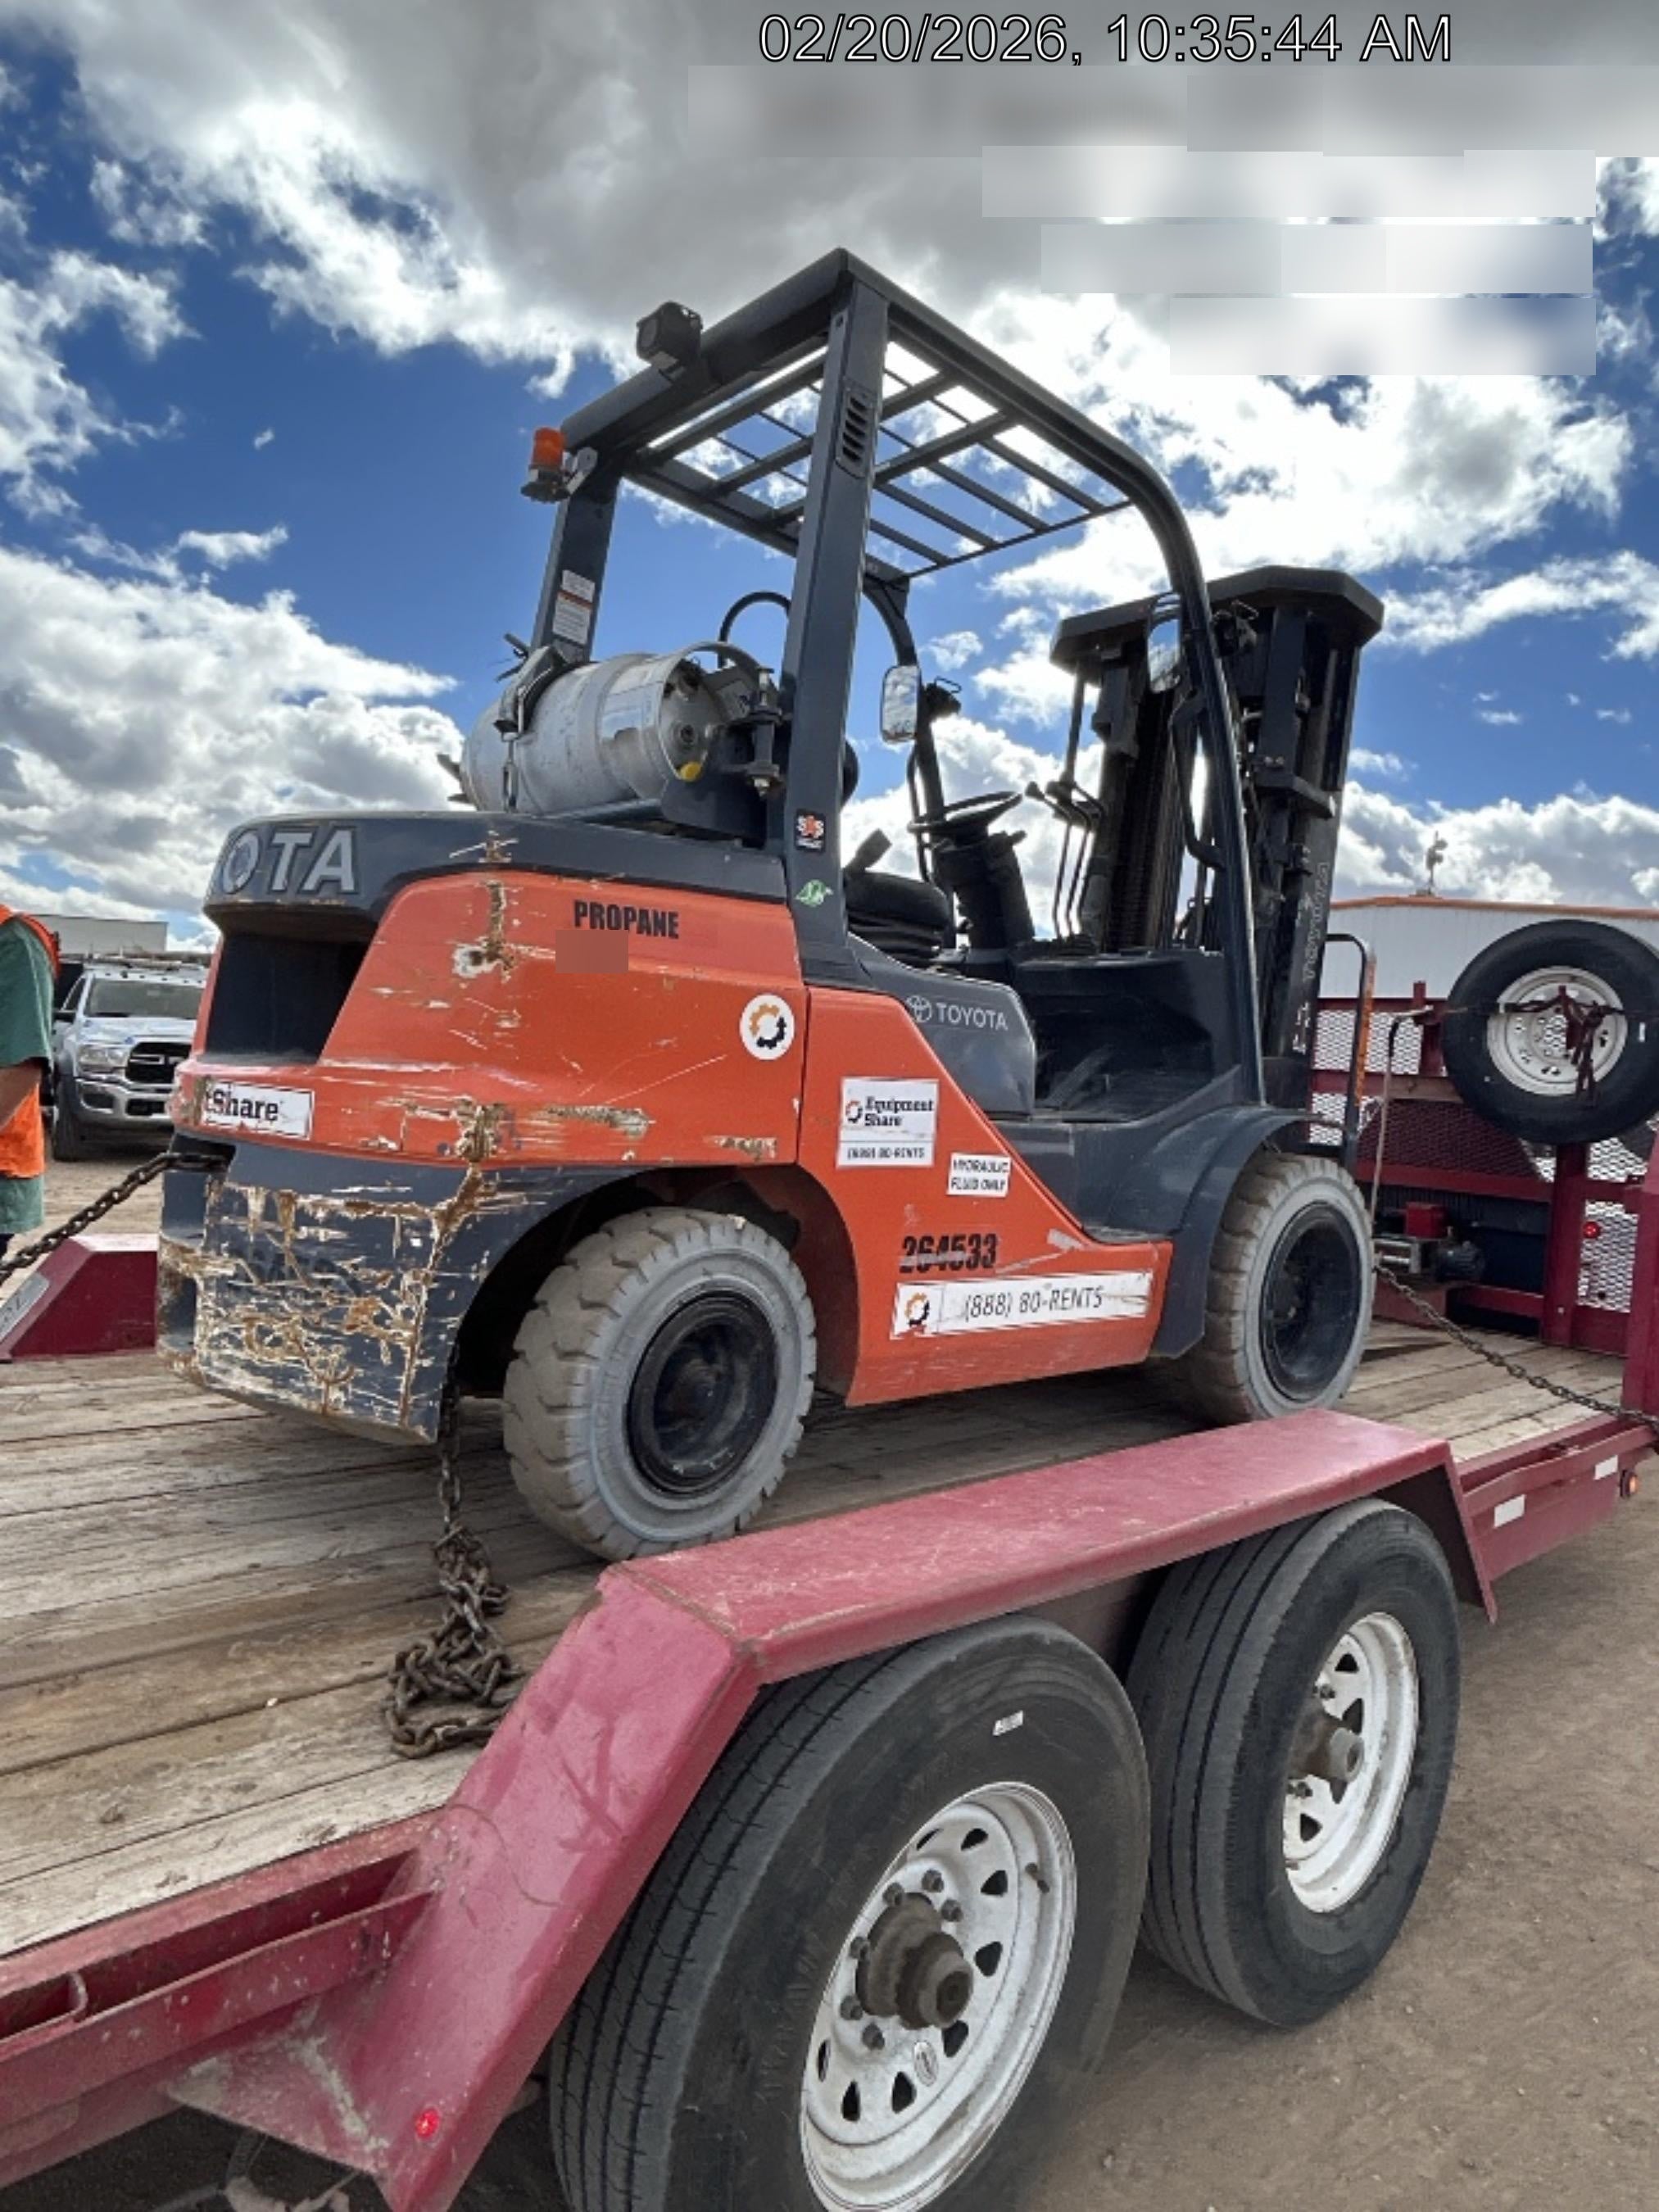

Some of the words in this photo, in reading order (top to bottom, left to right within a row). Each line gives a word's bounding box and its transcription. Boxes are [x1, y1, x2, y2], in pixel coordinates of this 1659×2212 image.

[574, 900, 679, 940] PROPANE
[936, 1002, 1009, 1031] TOYOTA
[864, 1113, 902, 1126] Share
[865, 1096, 933, 1114] Equipment
[899, 1233, 998, 1274] 264533
[964, 1291, 1013, 1321] (888)
[1019, 1285, 1104, 1314] 80-RENTS
